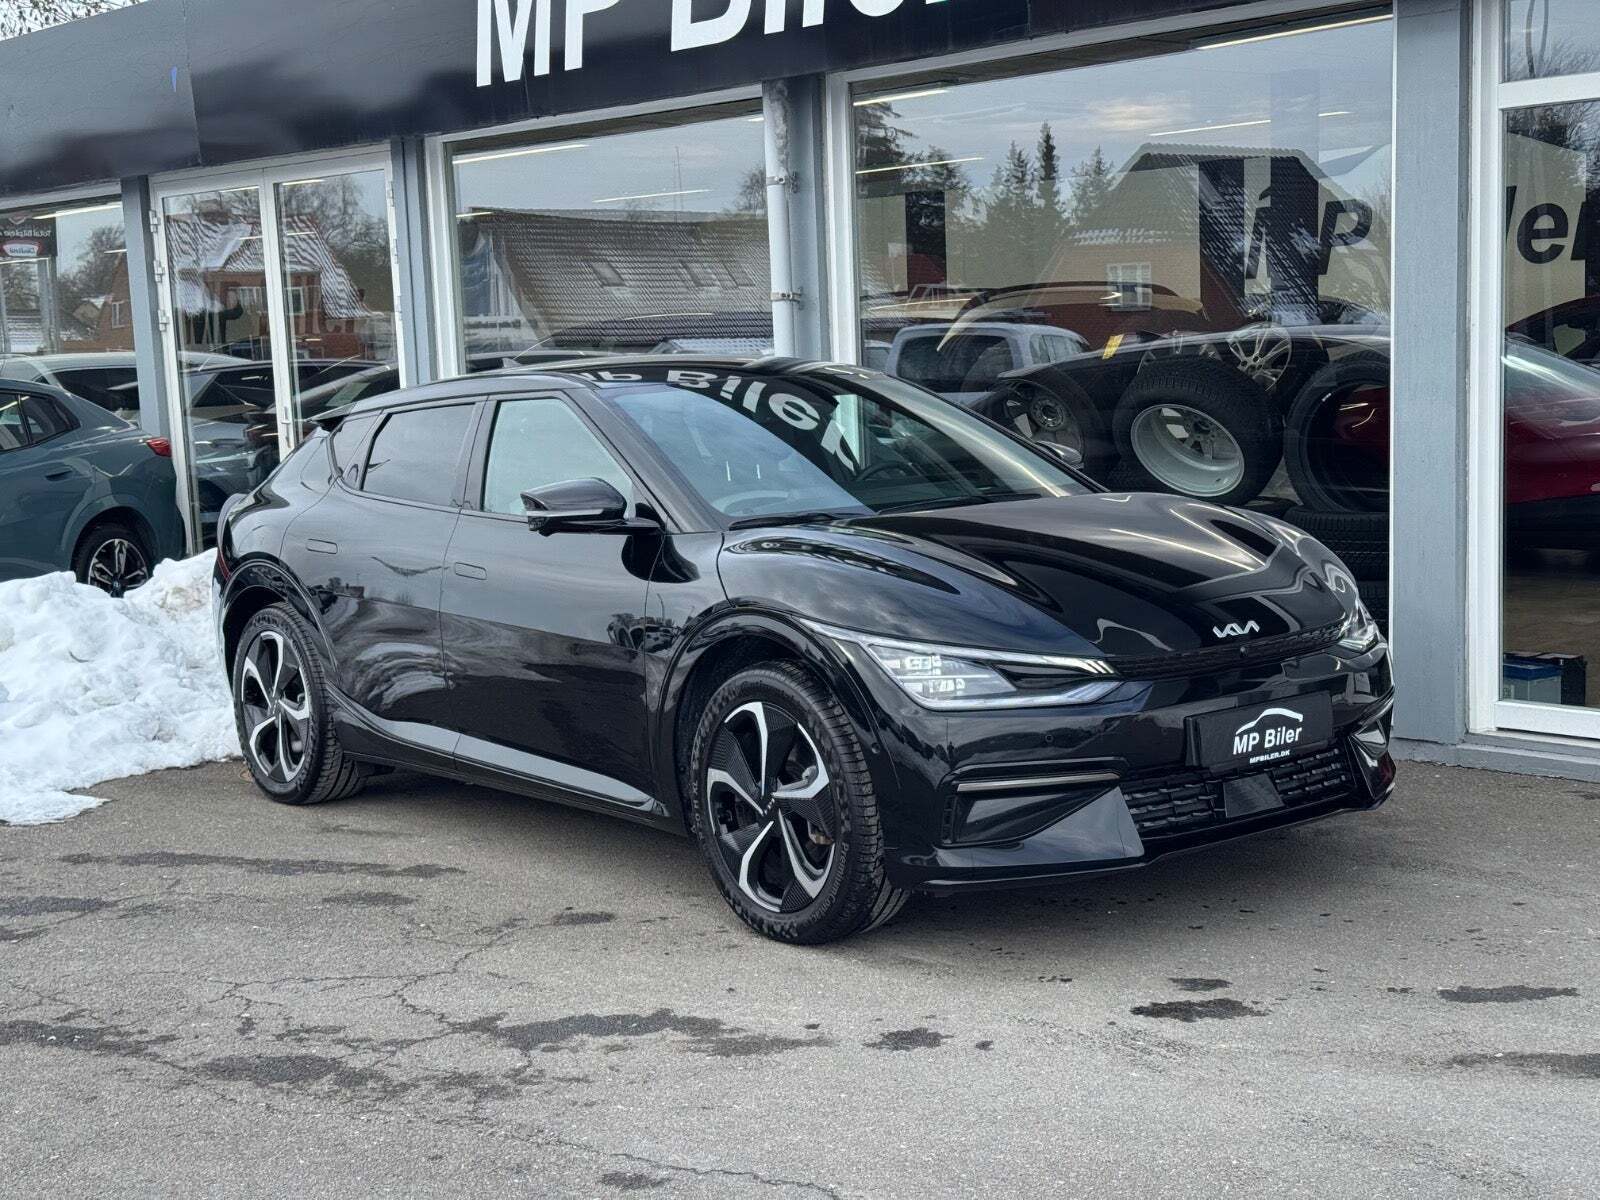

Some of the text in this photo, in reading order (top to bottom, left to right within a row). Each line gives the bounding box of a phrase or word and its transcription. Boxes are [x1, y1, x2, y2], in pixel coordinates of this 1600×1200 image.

[1212, 620, 1260, 638] KIA
[1232, 726, 1303, 755] MP Biler
[1249, 749, 1291, 764] MPBILER.DK
